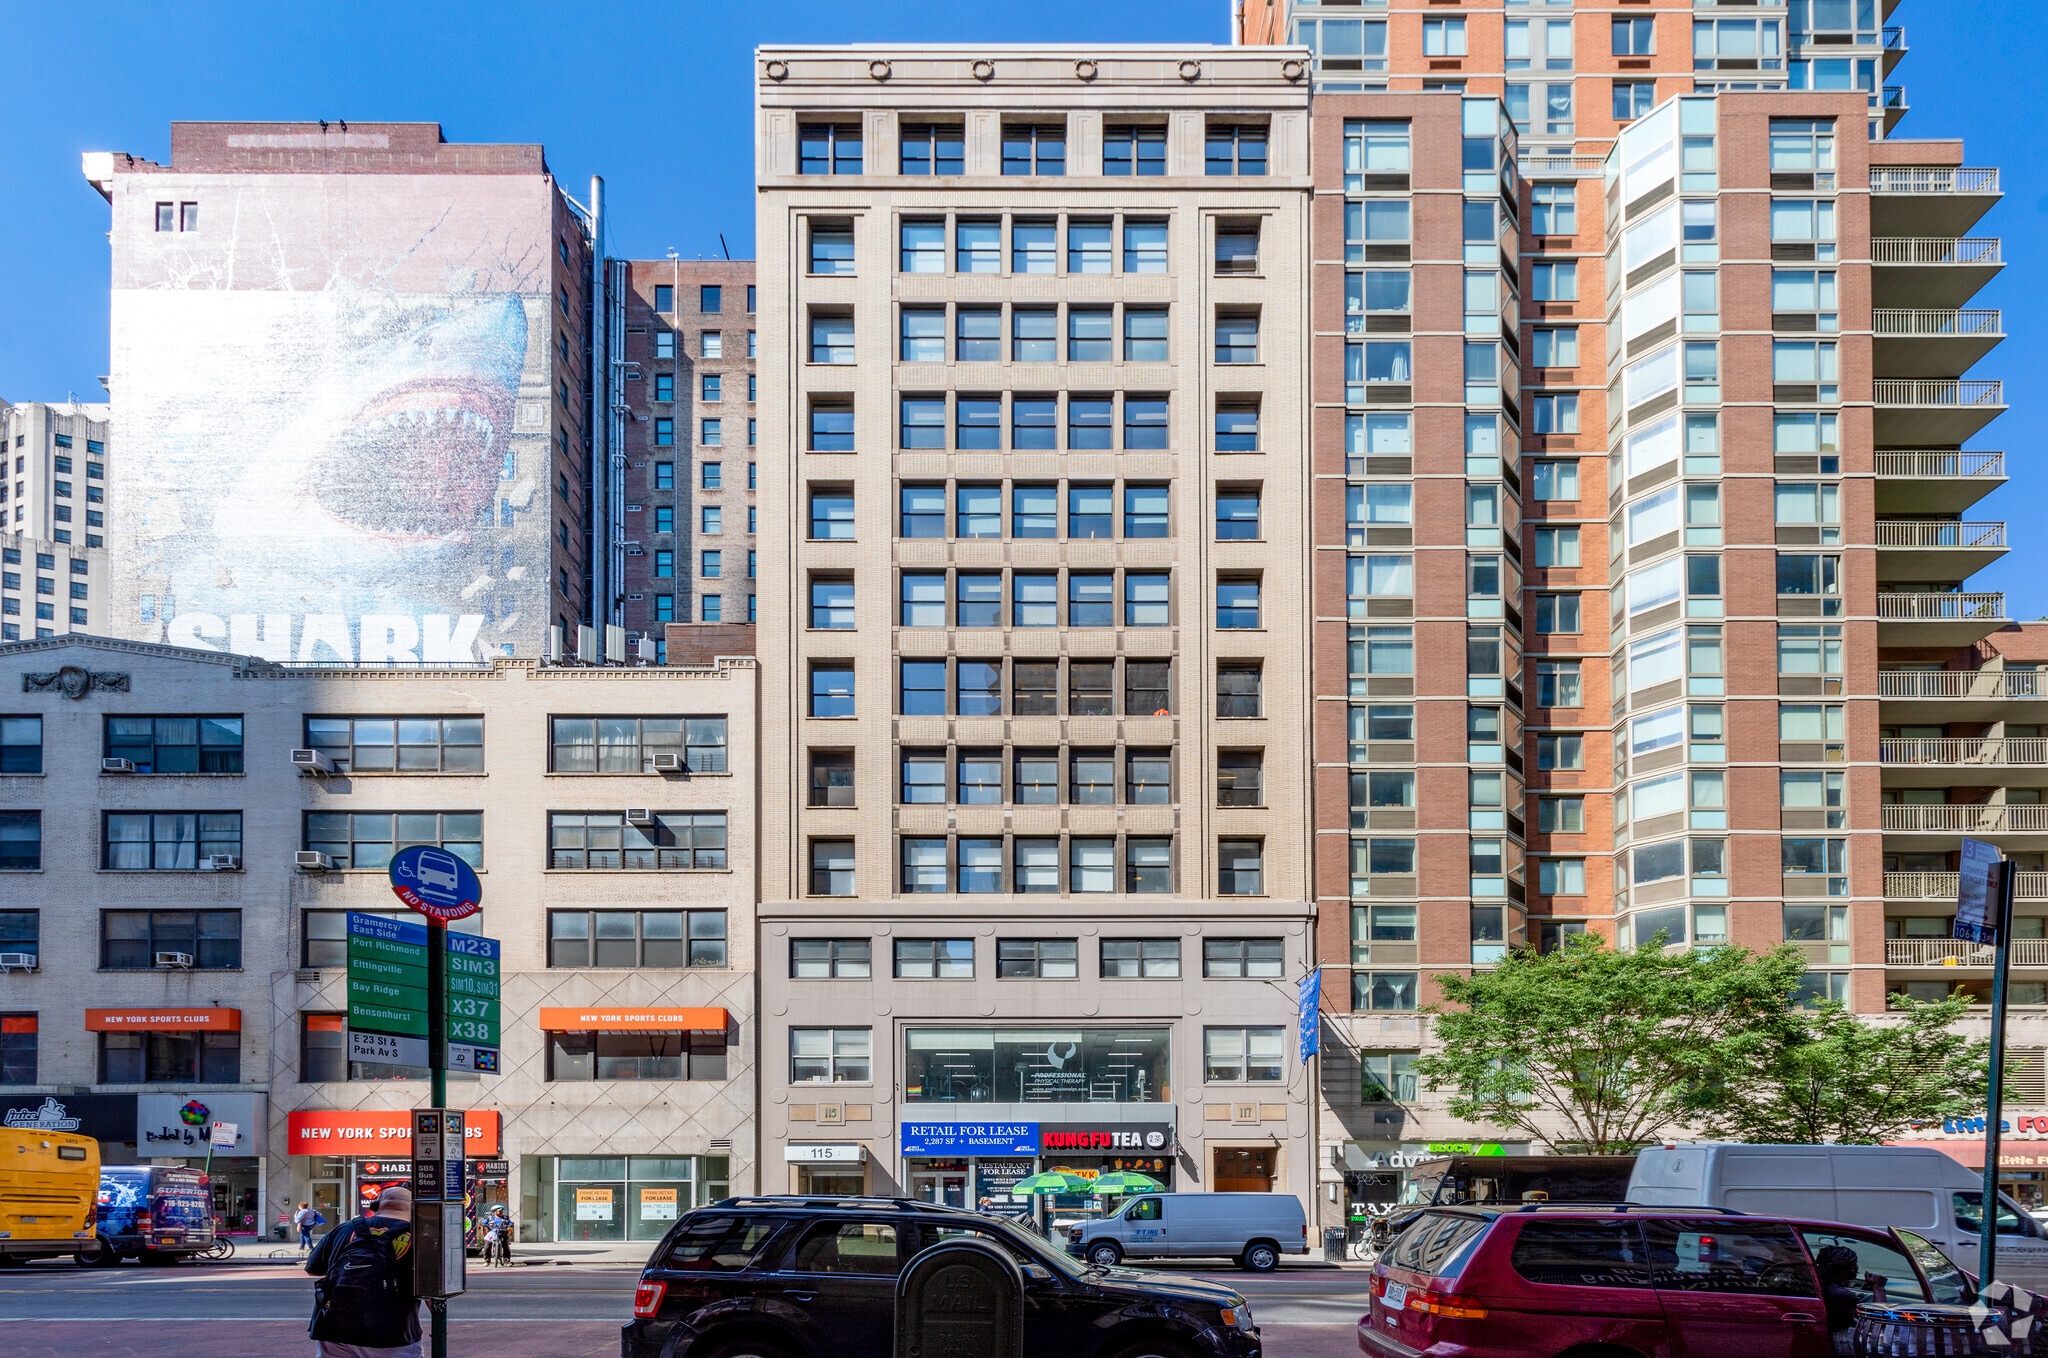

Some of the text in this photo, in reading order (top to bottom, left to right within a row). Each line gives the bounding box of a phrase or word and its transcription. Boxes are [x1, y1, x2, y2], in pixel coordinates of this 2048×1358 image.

[168, 612, 485, 668] SHARK
[1966, 842, 1975, 857] 3
[1962, 874, 1999, 889] VEHICLES ONLY
[402, 890, 475, 918] NO STANDING
[353, 915, 402, 931] Gramercy/
[353, 925, 397, 939] East Side
[353, 937, 420, 956] Port Richmond
[452, 938, 492, 957] M23
[452, 957, 496, 975] SIM3
[352, 982, 400, 997] Bay Ridge
[353, 1005, 411, 1021] Bensonhurst
[452, 999, 489, 1017] X37
[150, 1015, 182, 1023] SPORTS
[183, 1015, 210, 1023] CLUBS
[580, 1014, 684, 1022] NEW YORK SPORTS CLUBS
[452, 1022, 489, 1040] X38
[354, 1034, 397, 1047] E 23 St &
[354, 1045, 399, 1058] Park Av S
[6, 1108, 38, 1120] juice
[825, 1108, 837, 1118] 115
[1240, 1107, 1252, 1118] 117
[910, 1126, 1029, 1136] RETAIL FOR LEASE
[1943, 1116, 2010, 1134] Litte
[301, 1127, 332, 1139] NEW
[337, 1127, 374, 1139] YORK
[1112, 1131, 1142, 1147] TEA
[924, 1138, 943, 1146] 2,287
[1428, 1143, 1472, 1153] BLOCK
[811, 1148, 833, 1159] 115
[1074, 1171, 1096, 1179] TKK
[157, 1187, 209, 1195] SUPERIOR
[1351, 1202, 1396, 1216] TAX
